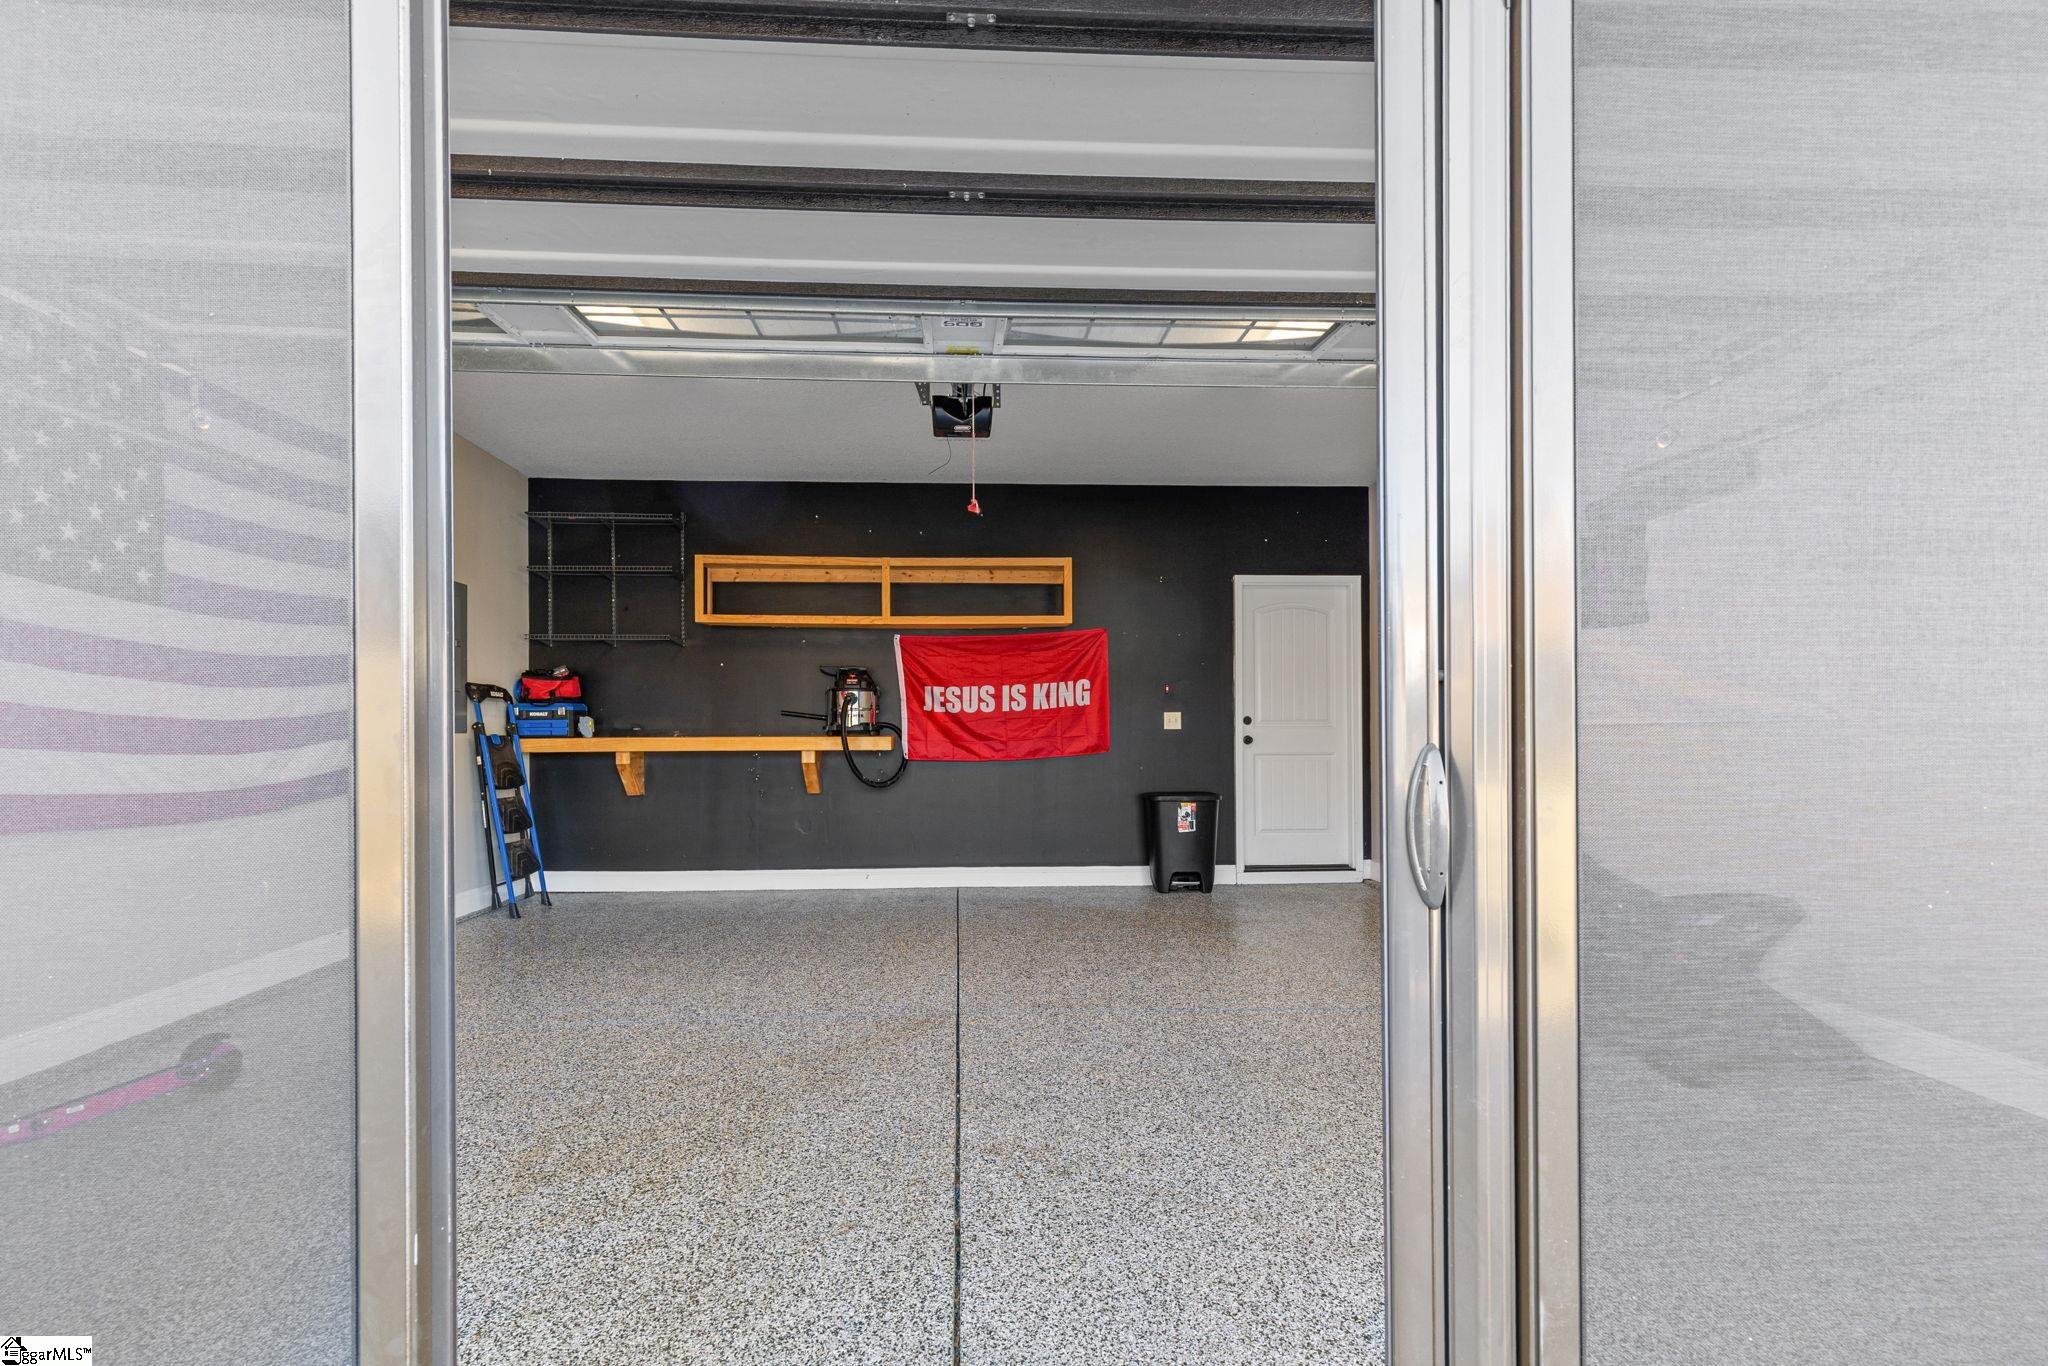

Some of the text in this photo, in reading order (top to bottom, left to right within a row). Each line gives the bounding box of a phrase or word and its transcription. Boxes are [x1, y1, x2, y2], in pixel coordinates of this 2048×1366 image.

[923, 678, 1092, 714] JESUS IS KING
